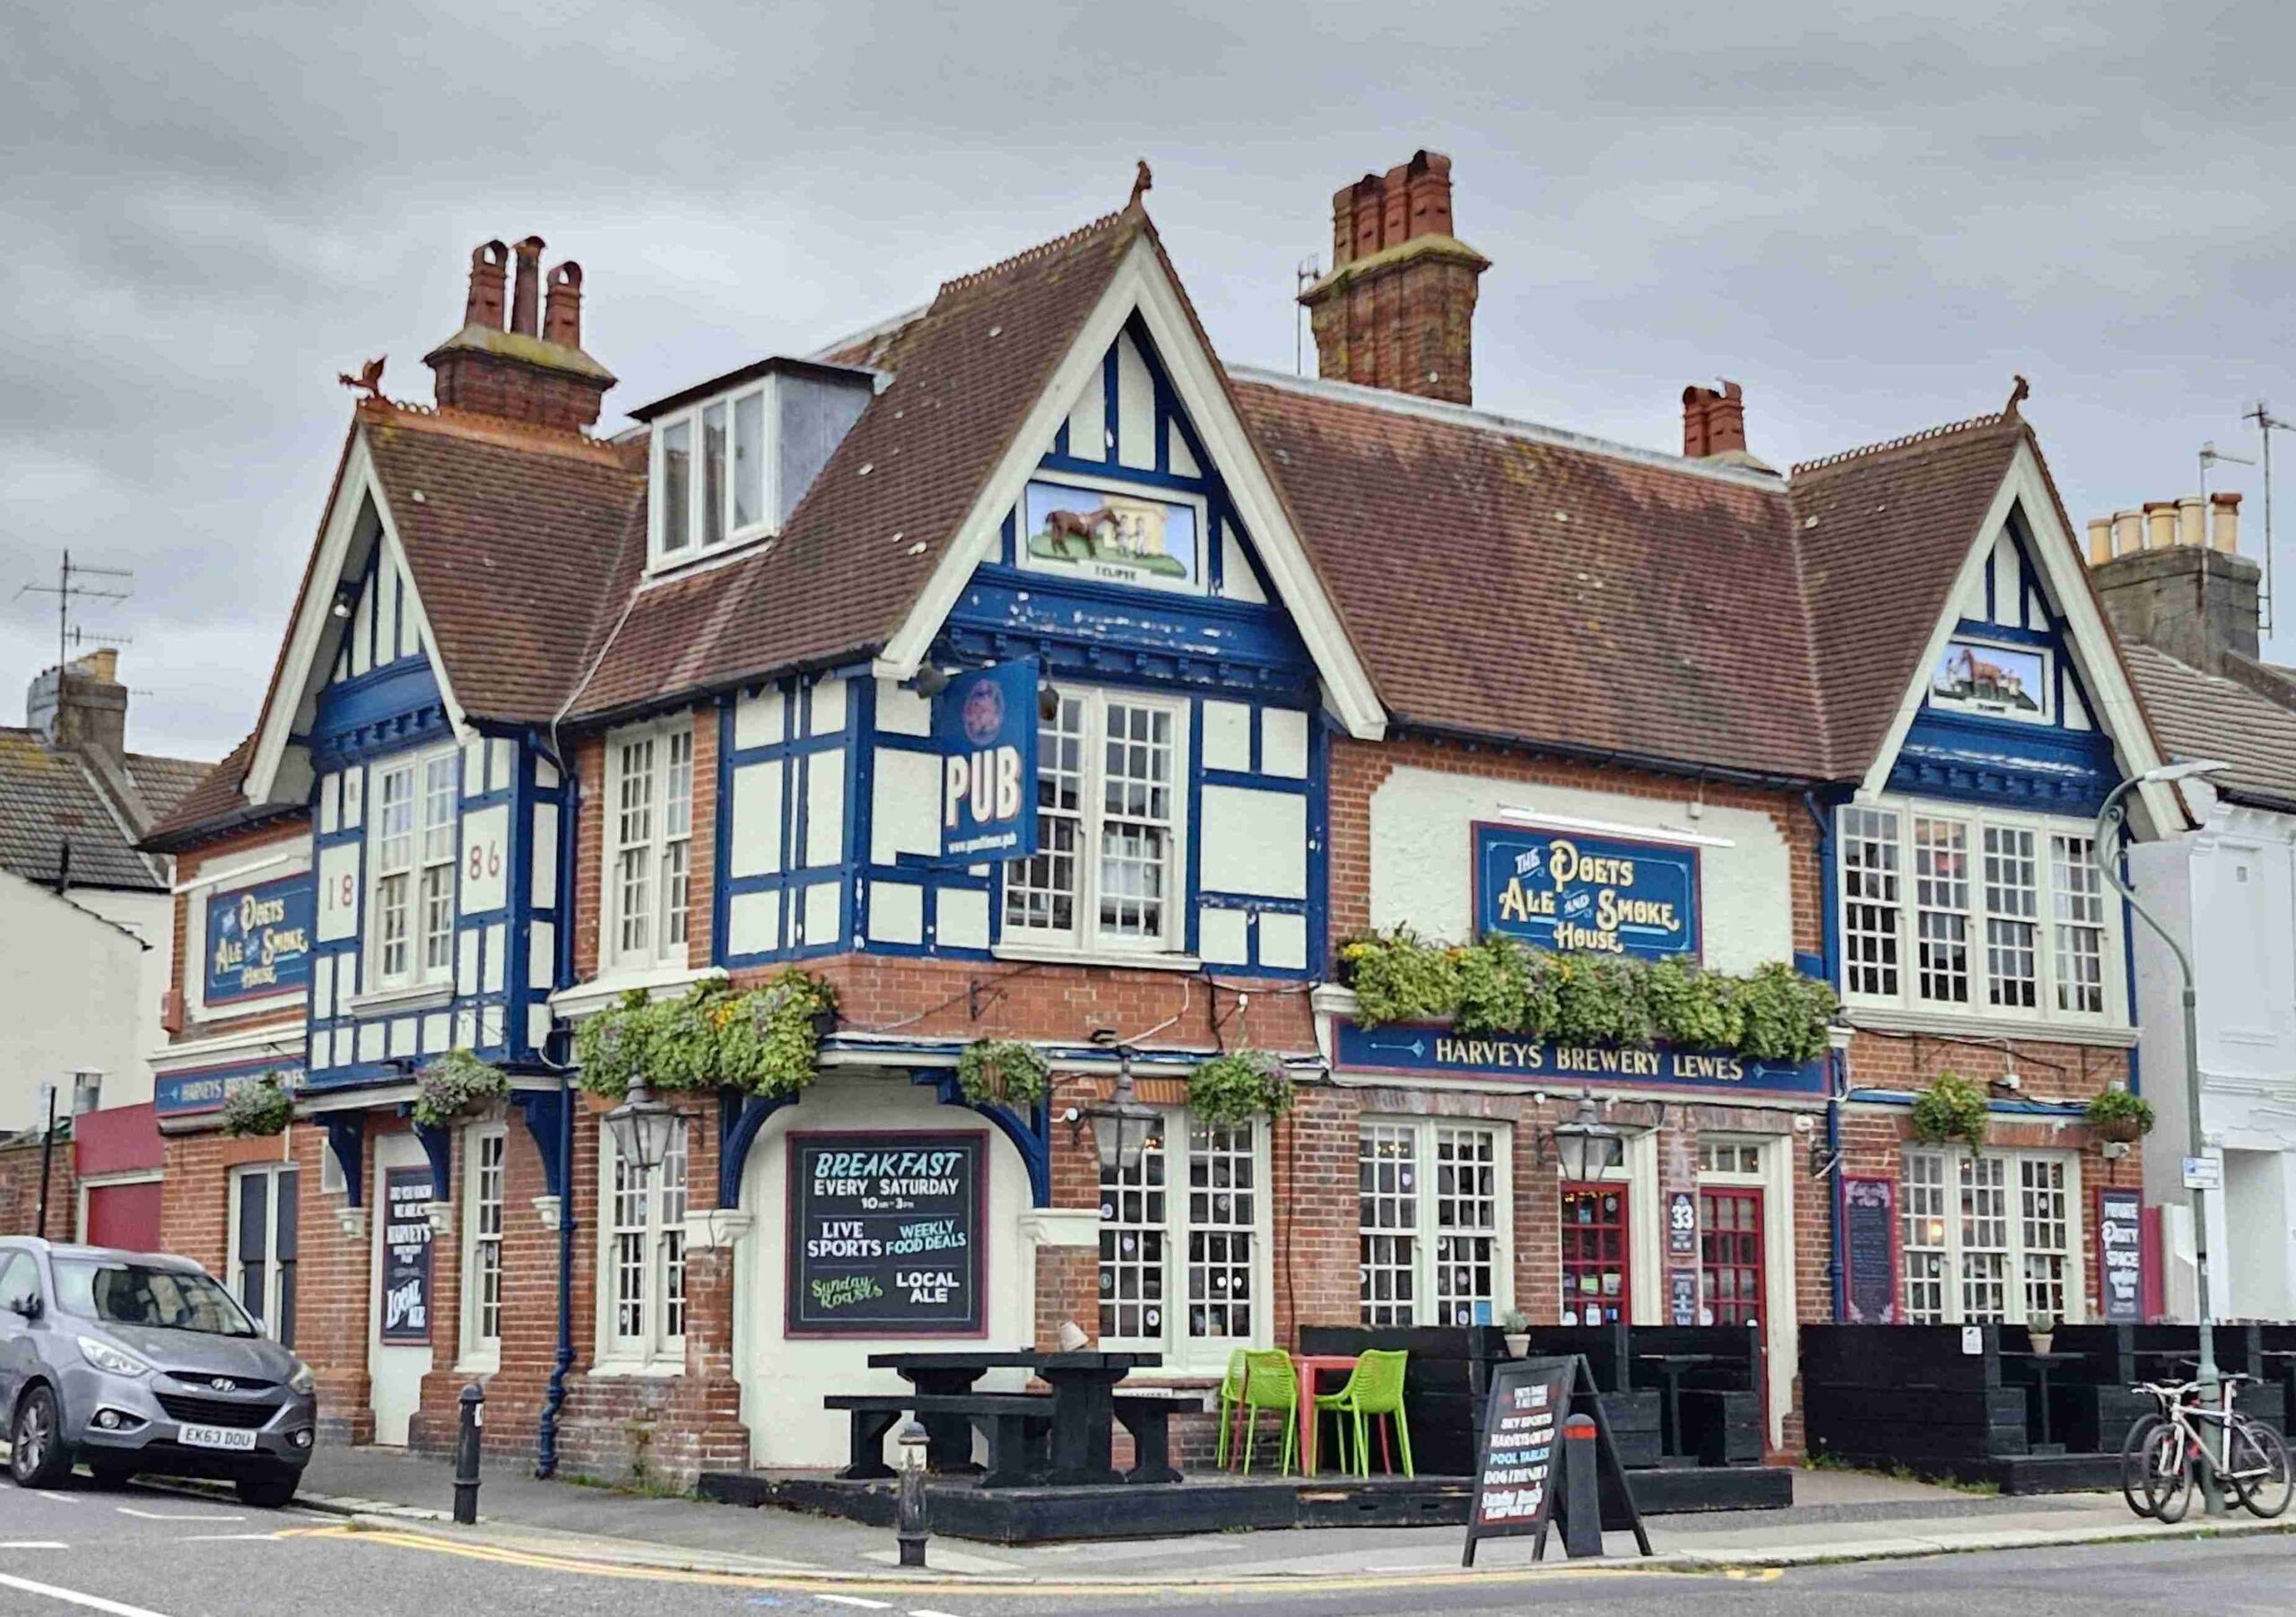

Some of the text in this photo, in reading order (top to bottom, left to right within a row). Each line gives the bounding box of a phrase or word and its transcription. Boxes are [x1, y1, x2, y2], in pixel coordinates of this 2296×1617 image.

[946, 746, 1021, 828] PUB
[328, 839, 500, 910] 18 86
[1515, 839, 1634, 892] THE POETS
[1499, 877, 1680, 931] ALE AND SMOKE
[1552, 921, 1623, 953] HOUSE
[215, 937, 243, 975] ALE
[262, 927, 309, 966] SMOKE
[1435, 1038, 1744, 1081] HARVEYS BREWERY LEWES
[814, 1152, 963, 1178] BREAKFAST
[813, 1178, 960, 1195] EVERY SATURDAY
[900, 1219, 955, 1239] WEEKLY
[1671, 1204, 1694, 1229] 33
[822, 1221, 865, 1239] LIVE
[807, 1239, 883, 1257] SPORTS
[885, 1231, 967, 1256] FOOD DEALS
[811, 1274, 875, 1297] Sunday
[895, 1272, 961, 1288] LOCAL
[386, 1279, 422, 1328] LOCAL
[820, 1284, 883, 1309] Roasts
[909, 1288, 949, 1303] ALE
[186, 1427, 251, 1447] EK63 DOU
[1490, 1452, 1518, 1465] POOL
[1483, 1469, 1508, 1485] DOG
